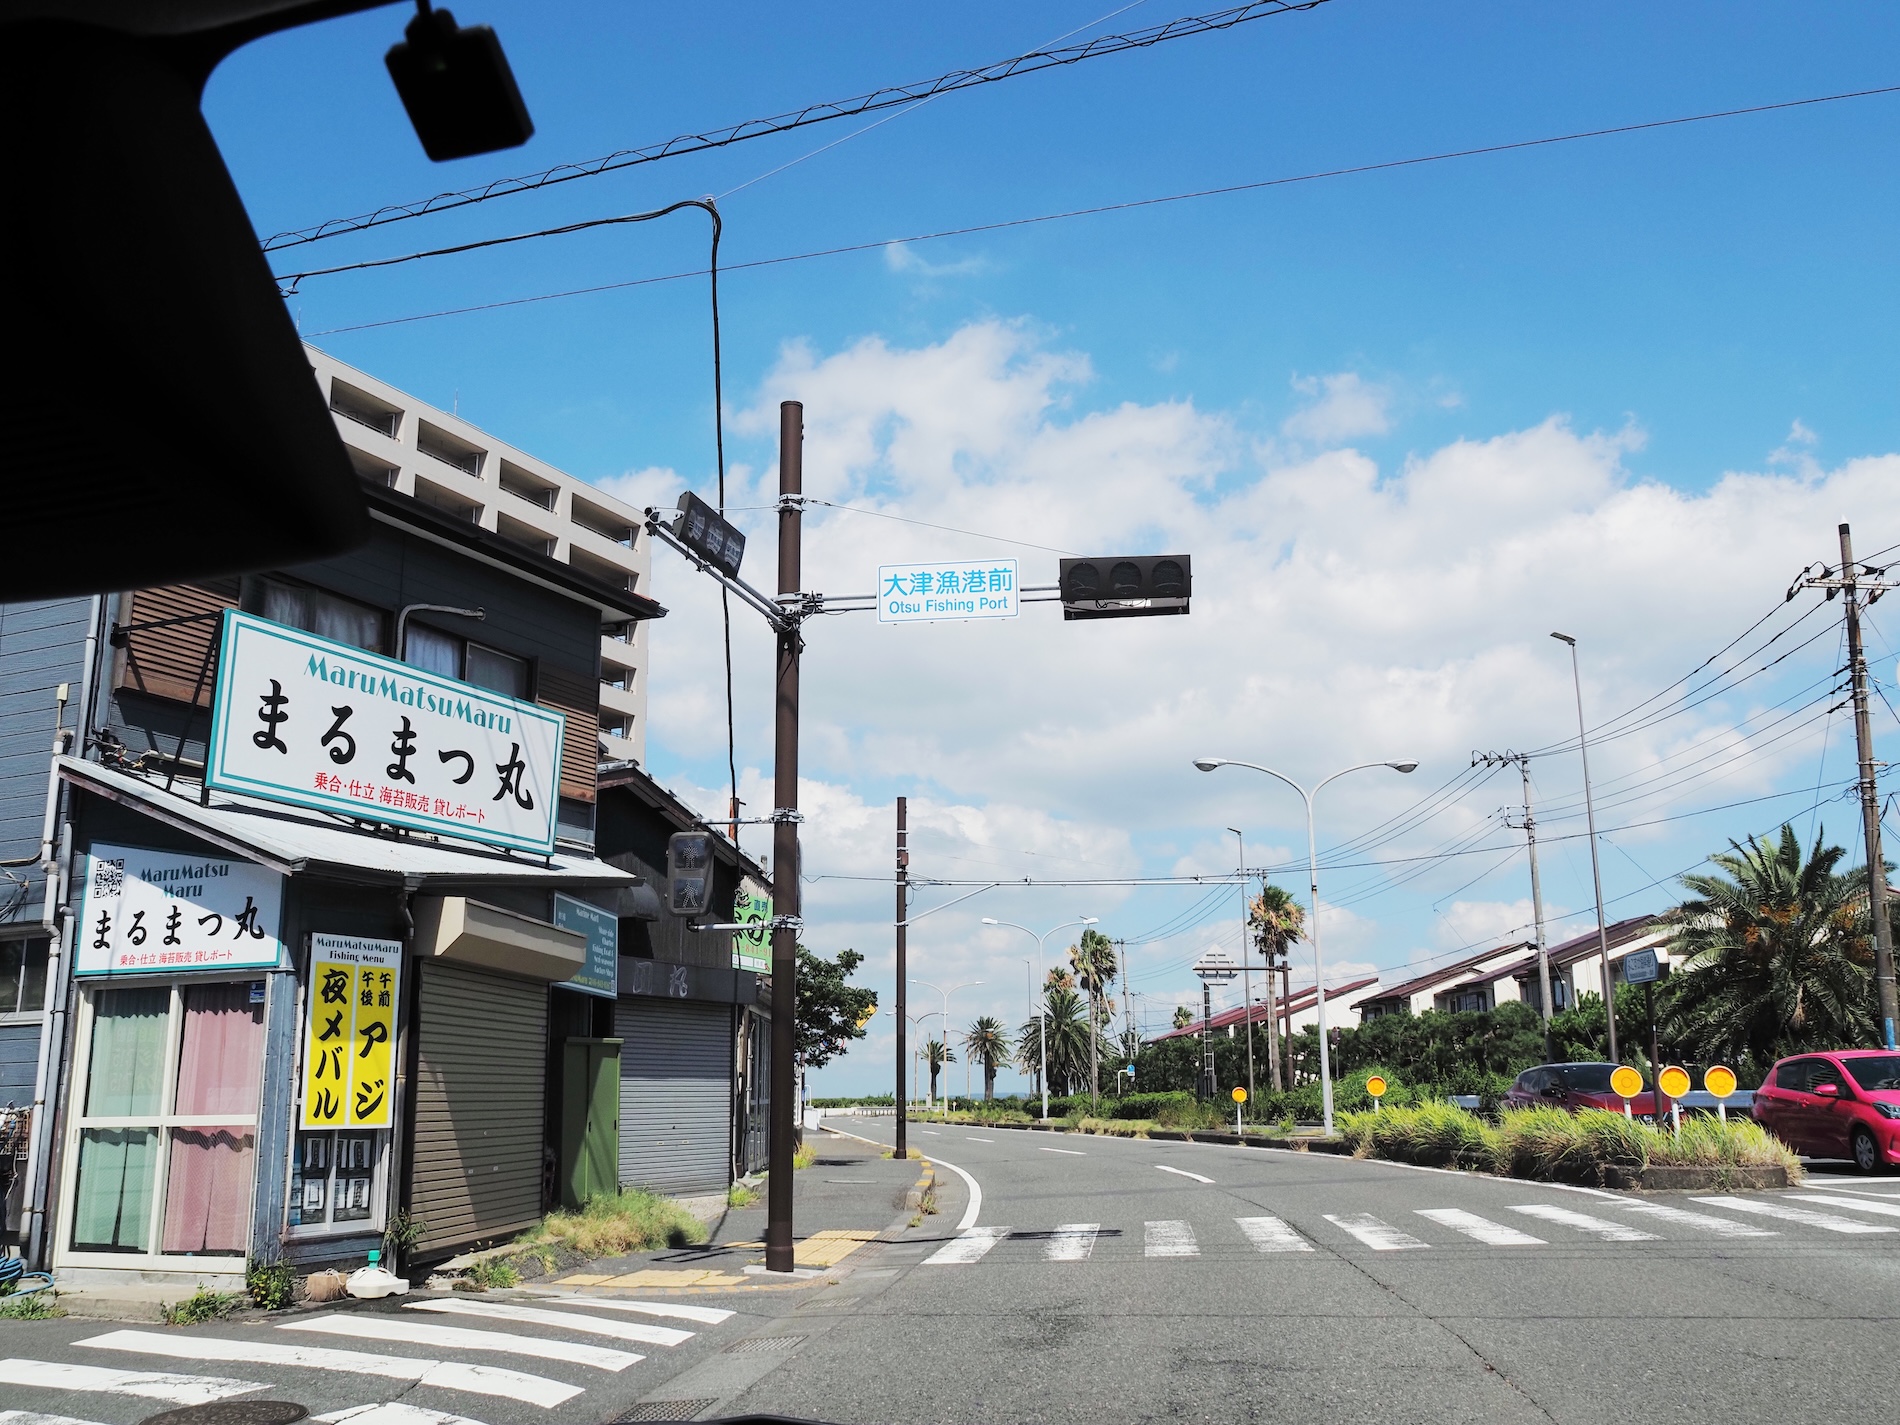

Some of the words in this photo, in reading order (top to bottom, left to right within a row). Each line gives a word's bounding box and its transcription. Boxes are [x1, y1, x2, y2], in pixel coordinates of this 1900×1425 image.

[883, 567, 1013, 597] 大津漁港前
[889, 600, 921, 614] Otsu
[926, 598, 974, 613] Fishing
[980, 596, 1009, 610] Port
[304, 652, 511, 735] MaruMatsuMaru
[252, 678, 534, 811] まるまつ丸
[378, 785, 430, 814] 海苔販売
[433, 798, 486, 824] 貸しボート
[139, 863, 229, 883] MaruMatsu
[161, 884, 203, 899] Maru
[93, 895, 265, 950] まるまつ丸
[159, 951, 192, 965] 海苔販売
[195, 949, 233, 963] 貸しボート
[316, 936, 399, 954] MaruMatsuMaru
[329, 950, 360, 963] Fishing
[362, 954, 385, 964] Menu
[360, 970, 374, 1007] 午後
[378, 972, 392, 1008] 午前
[312, 968, 349, 1120] 夜メバル
[355, 1021, 388, 1120] アジ
